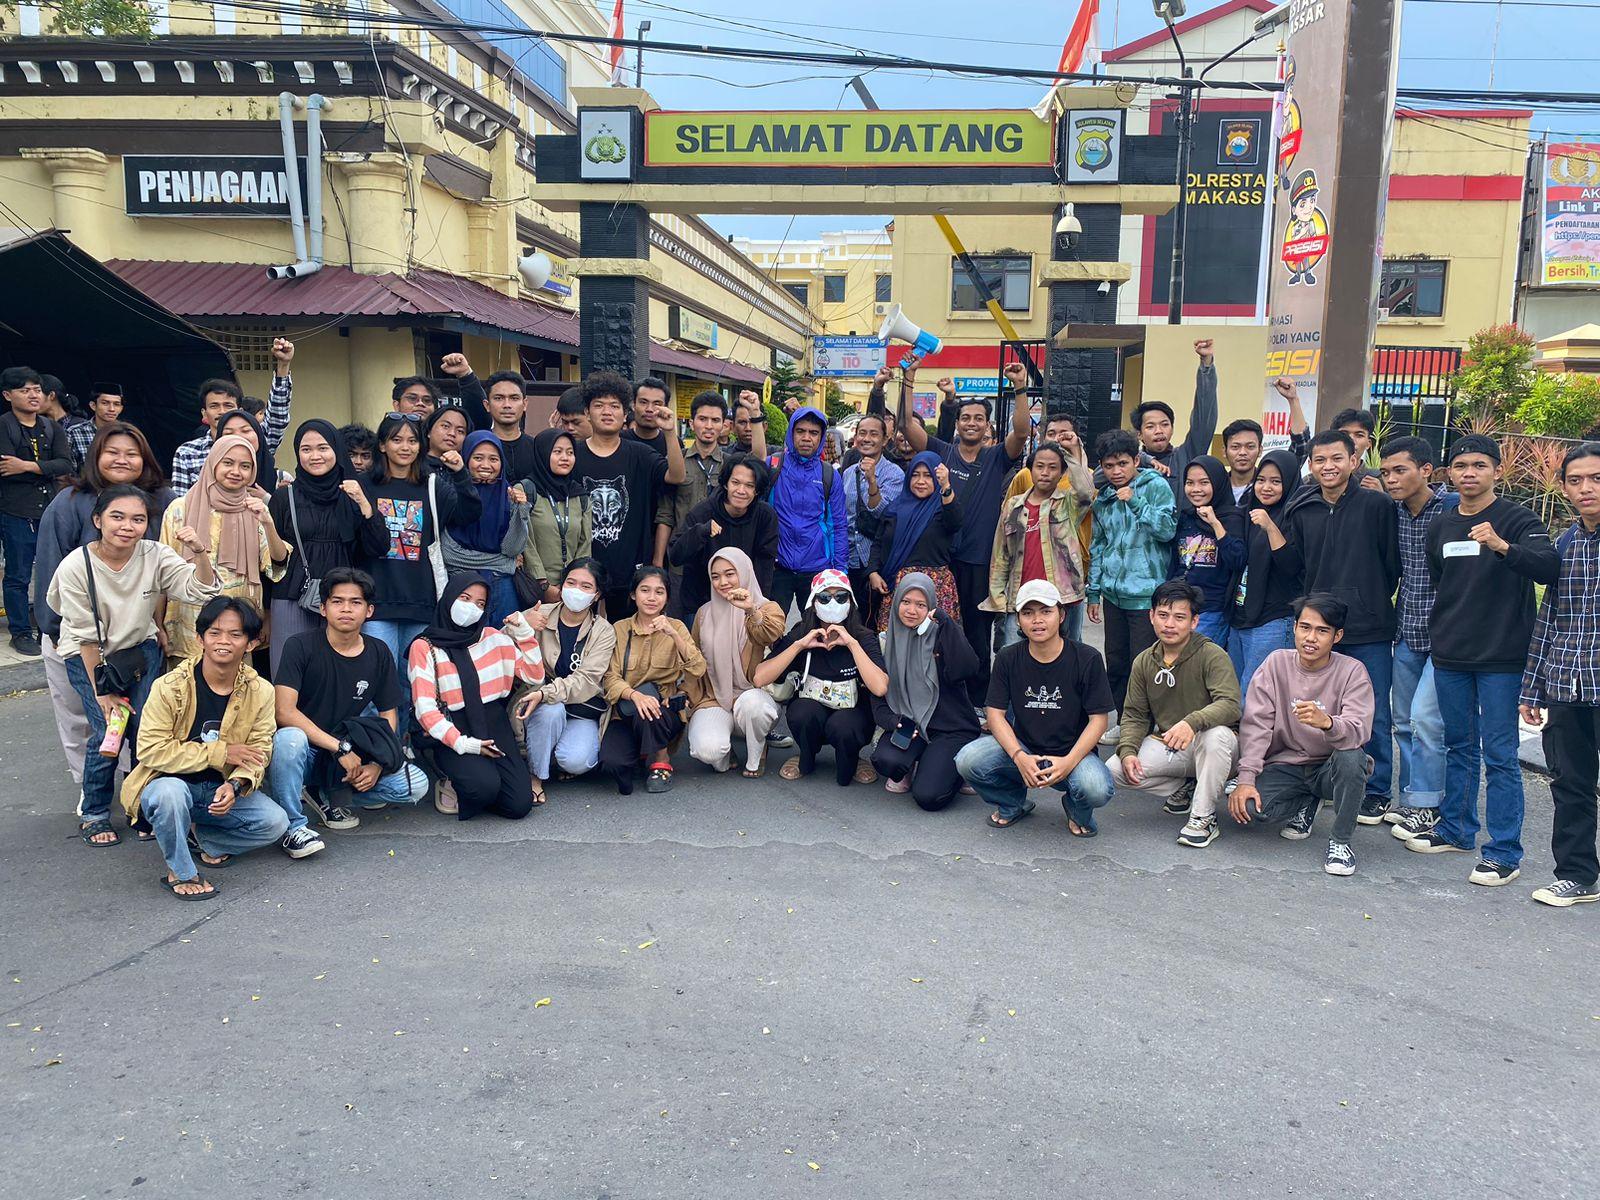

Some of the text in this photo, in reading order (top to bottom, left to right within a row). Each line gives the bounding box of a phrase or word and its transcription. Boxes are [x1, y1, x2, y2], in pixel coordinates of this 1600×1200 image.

[676, 124, 1023, 153] SELAMAT DATANG
[1187, 173, 1279, 188] OLRESTA
[1186, 190, 1276, 205] MAKASS
[1559, 201, 1586, 212] Link
[1548, 264, 1589, 278] Bersih,
[1290, 331, 1320, 343] YANG
[841, 356, 861, 368] 110
